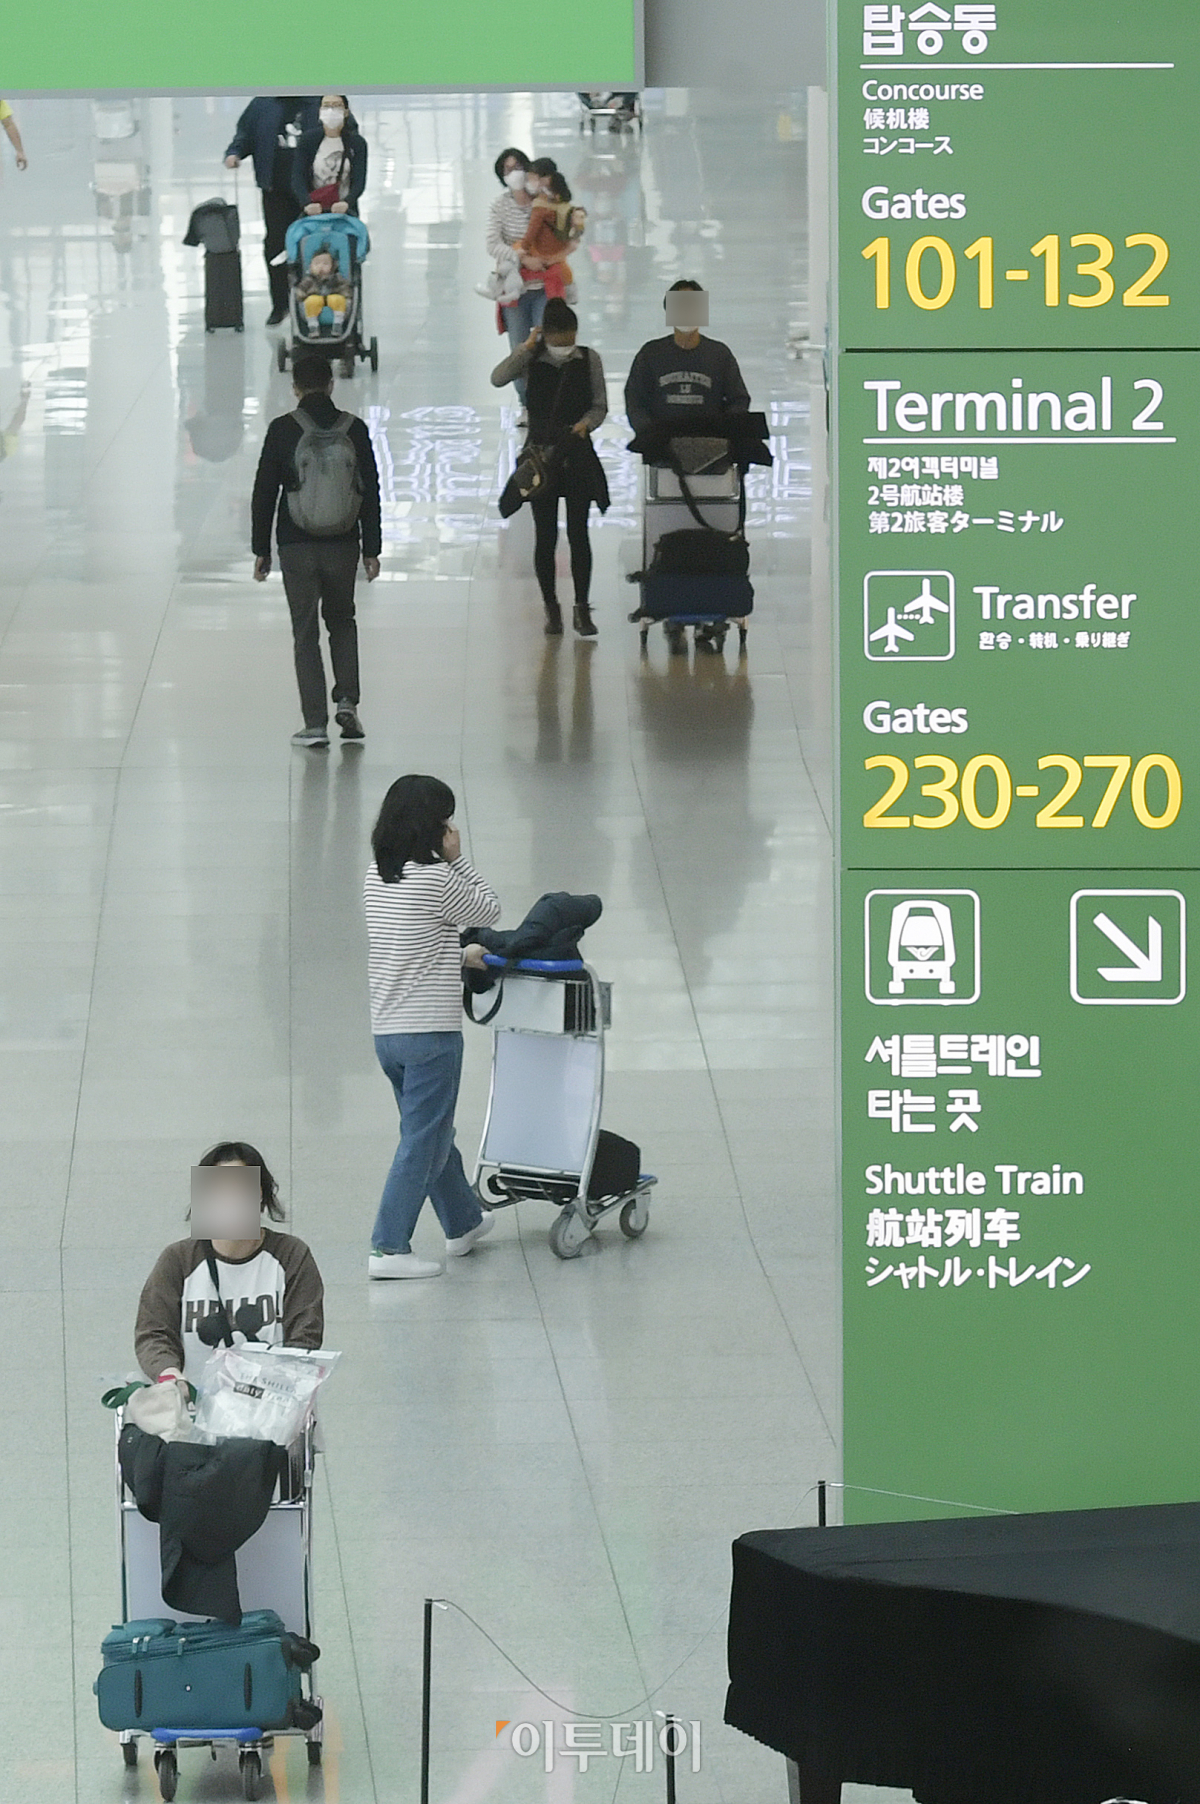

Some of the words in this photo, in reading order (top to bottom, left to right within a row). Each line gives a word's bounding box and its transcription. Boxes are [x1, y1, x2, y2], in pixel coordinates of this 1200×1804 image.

[862, 2, 997, 56] 탑승동
[862, 80, 985, 101] Concourse
[863, 107, 930, 130] 候机楼
[863, 136, 954, 156] コンコース
[862, 185, 967, 220] Gates
[861, 232, 1170, 311] 101-132
[863, 376, 1112, 432] Terminal
[1132, 378, 1165, 431] 2
[867, 456, 999, 480] 제2여객터미널
[867, 483, 965, 507] 2号航站楼
[868, 509, 1064, 535] 第2旅客ターミナル
[972, 583, 1137, 620] Transfer
[978, 631, 1012, 651] 환승
[862, 700, 969, 734] Gates
[862, 753, 1182, 830] 230-270
[864, 1034, 1042, 1078] 셔틀트레인
[867, 1088, 936, 1133] 타는
[945, 1089, 983, 1133] 곳
[865, 1163, 987, 1195] Shuttle
[994, 1164, 1084, 1195] Train
[866, 1207, 1021, 1249] 航站列车
[185, 1291, 285, 1333] HLO!
